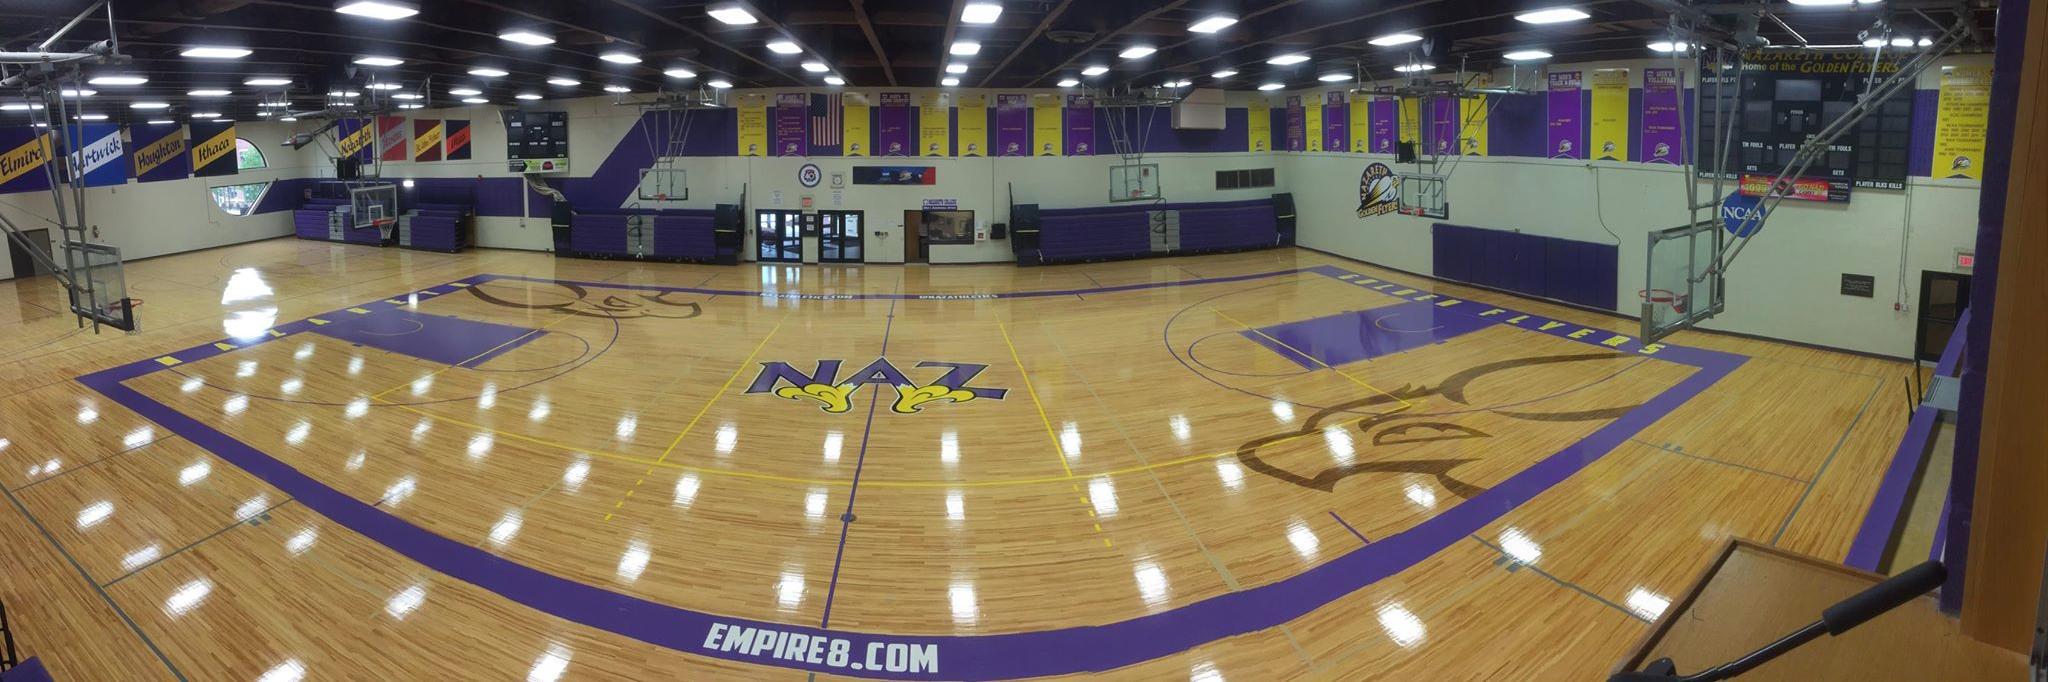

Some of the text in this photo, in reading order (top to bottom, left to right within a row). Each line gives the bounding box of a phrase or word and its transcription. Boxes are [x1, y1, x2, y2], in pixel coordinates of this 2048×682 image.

[1741, 62, 1766, 71] Home
[1769, 62, 1779, 71] of
[1781, 62, 1796, 71] the
[137, 138, 182, 168] Houghton
[198, 137, 230, 163] Ithaca
[1361, 165, 1388, 200] NAZARETH
[1855, 180, 1874, 188] PLAYER
[1723, 206, 1763, 221] NCAA
[1338, 274, 1667, 355] GOLDEN FLYERS
[744, 355, 1009, 413] NAZ
[703, 622, 939, 674] EMPIRE8.COM
